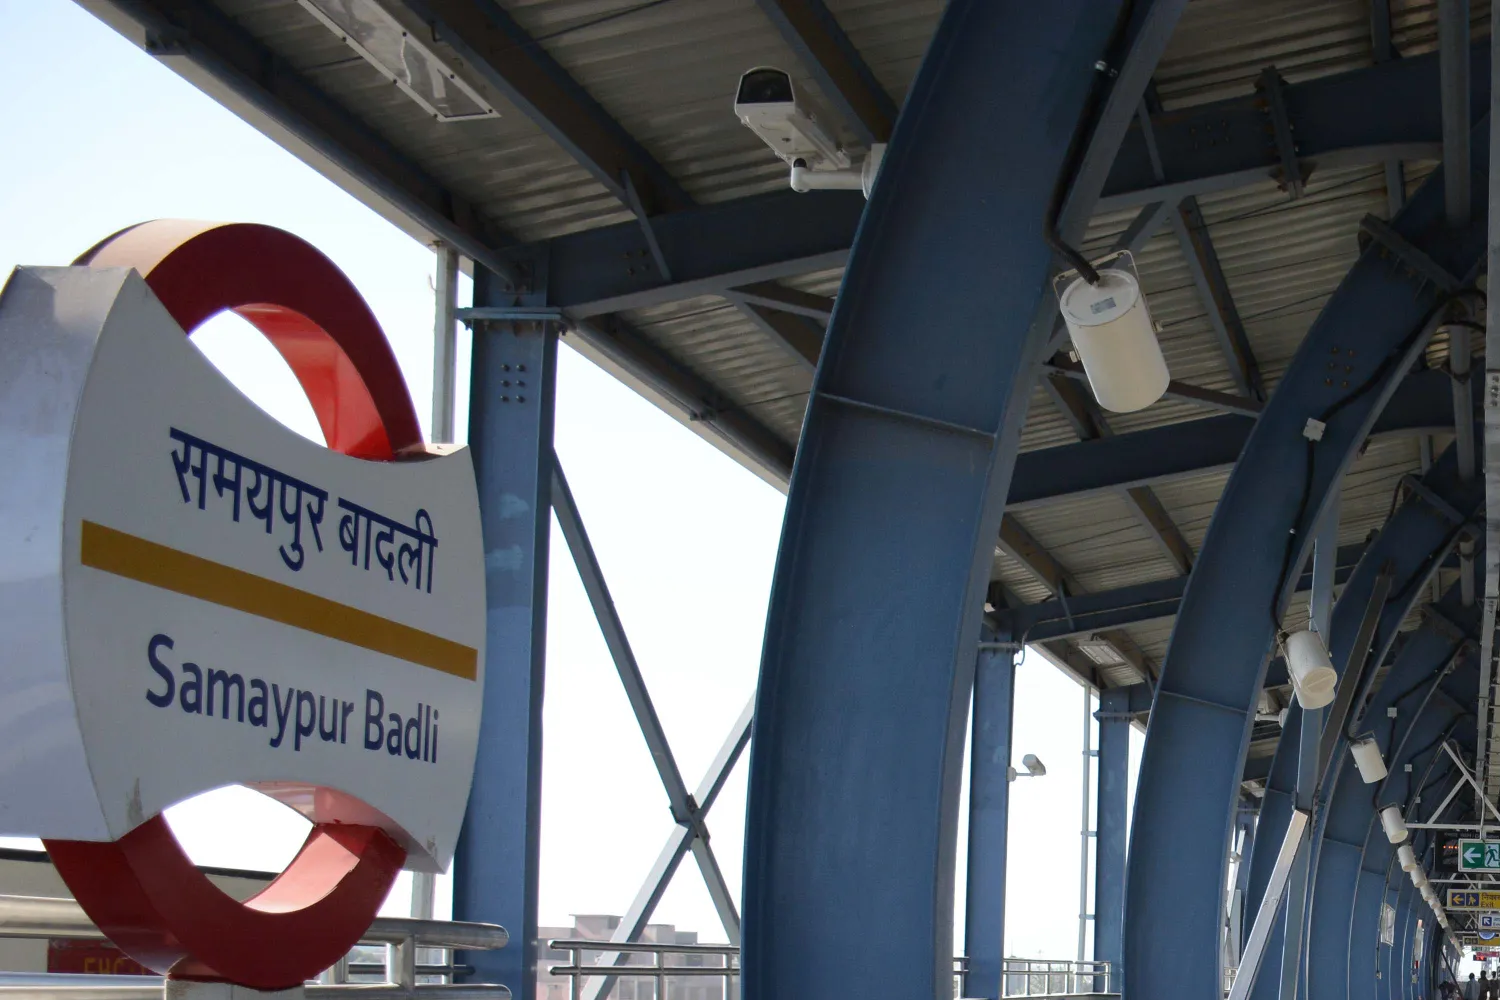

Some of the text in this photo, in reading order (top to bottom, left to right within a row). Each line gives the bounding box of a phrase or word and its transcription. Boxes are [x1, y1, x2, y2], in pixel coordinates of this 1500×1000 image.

[170, 428, 439, 594] समयपुर बादली
[146, 634, 440, 764] Samaypur Badli
